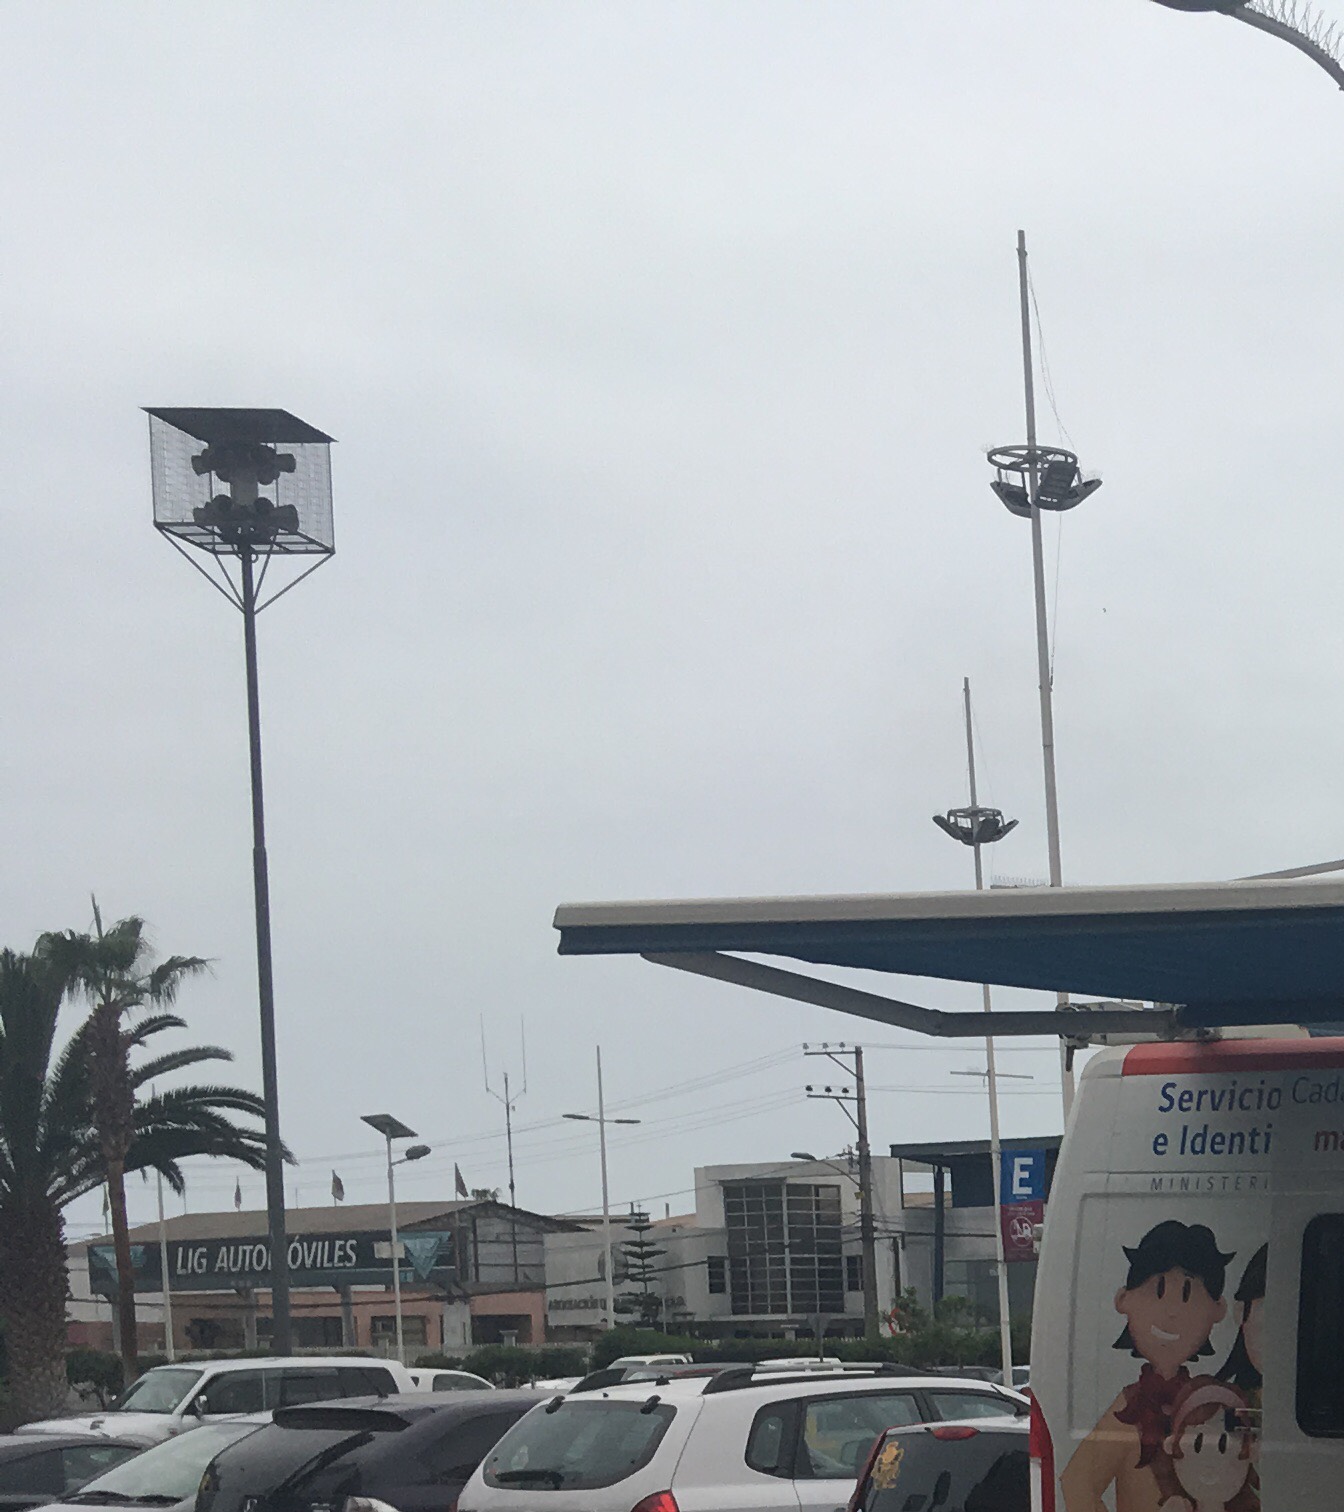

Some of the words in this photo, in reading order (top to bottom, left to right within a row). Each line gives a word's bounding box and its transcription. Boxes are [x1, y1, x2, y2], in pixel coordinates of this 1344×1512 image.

[1158, 1080, 1282, 1113] Servicio
[1152, 1132, 1169, 1156] e
[1179, 1123, 1273, 1155] Identi
[1012, 1157, 1034, 1195] E
[1150, 1176, 1268, 1191] MINISTERI
[177, 1246, 207, 1275] LIG
[215, 1235, 357, 1272] AUTOÓVILES
